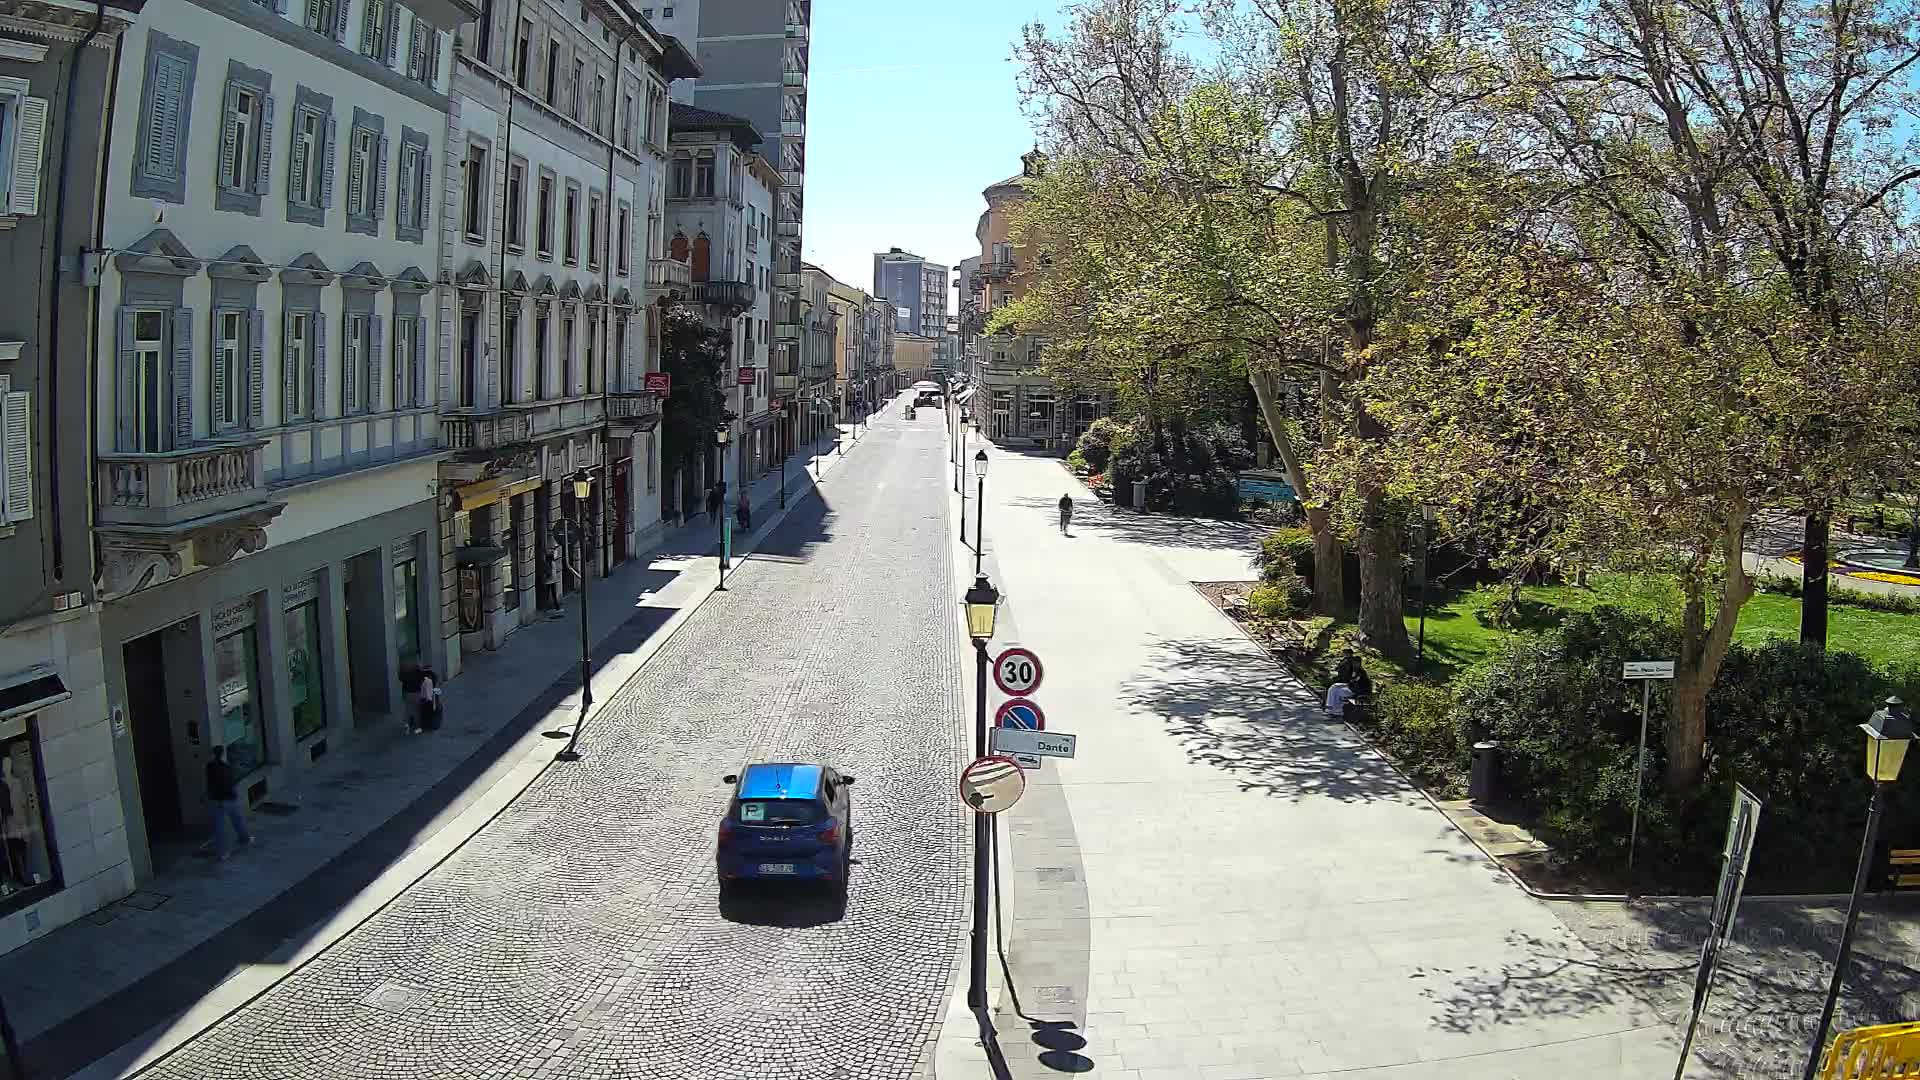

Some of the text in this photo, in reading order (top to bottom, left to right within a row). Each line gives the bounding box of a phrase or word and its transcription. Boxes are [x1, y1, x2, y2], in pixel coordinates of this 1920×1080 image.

[1005, 661, 1032, 683] 30
[1037, 741, 1069, 753] Dante
[745, 804, 759, 816] P
